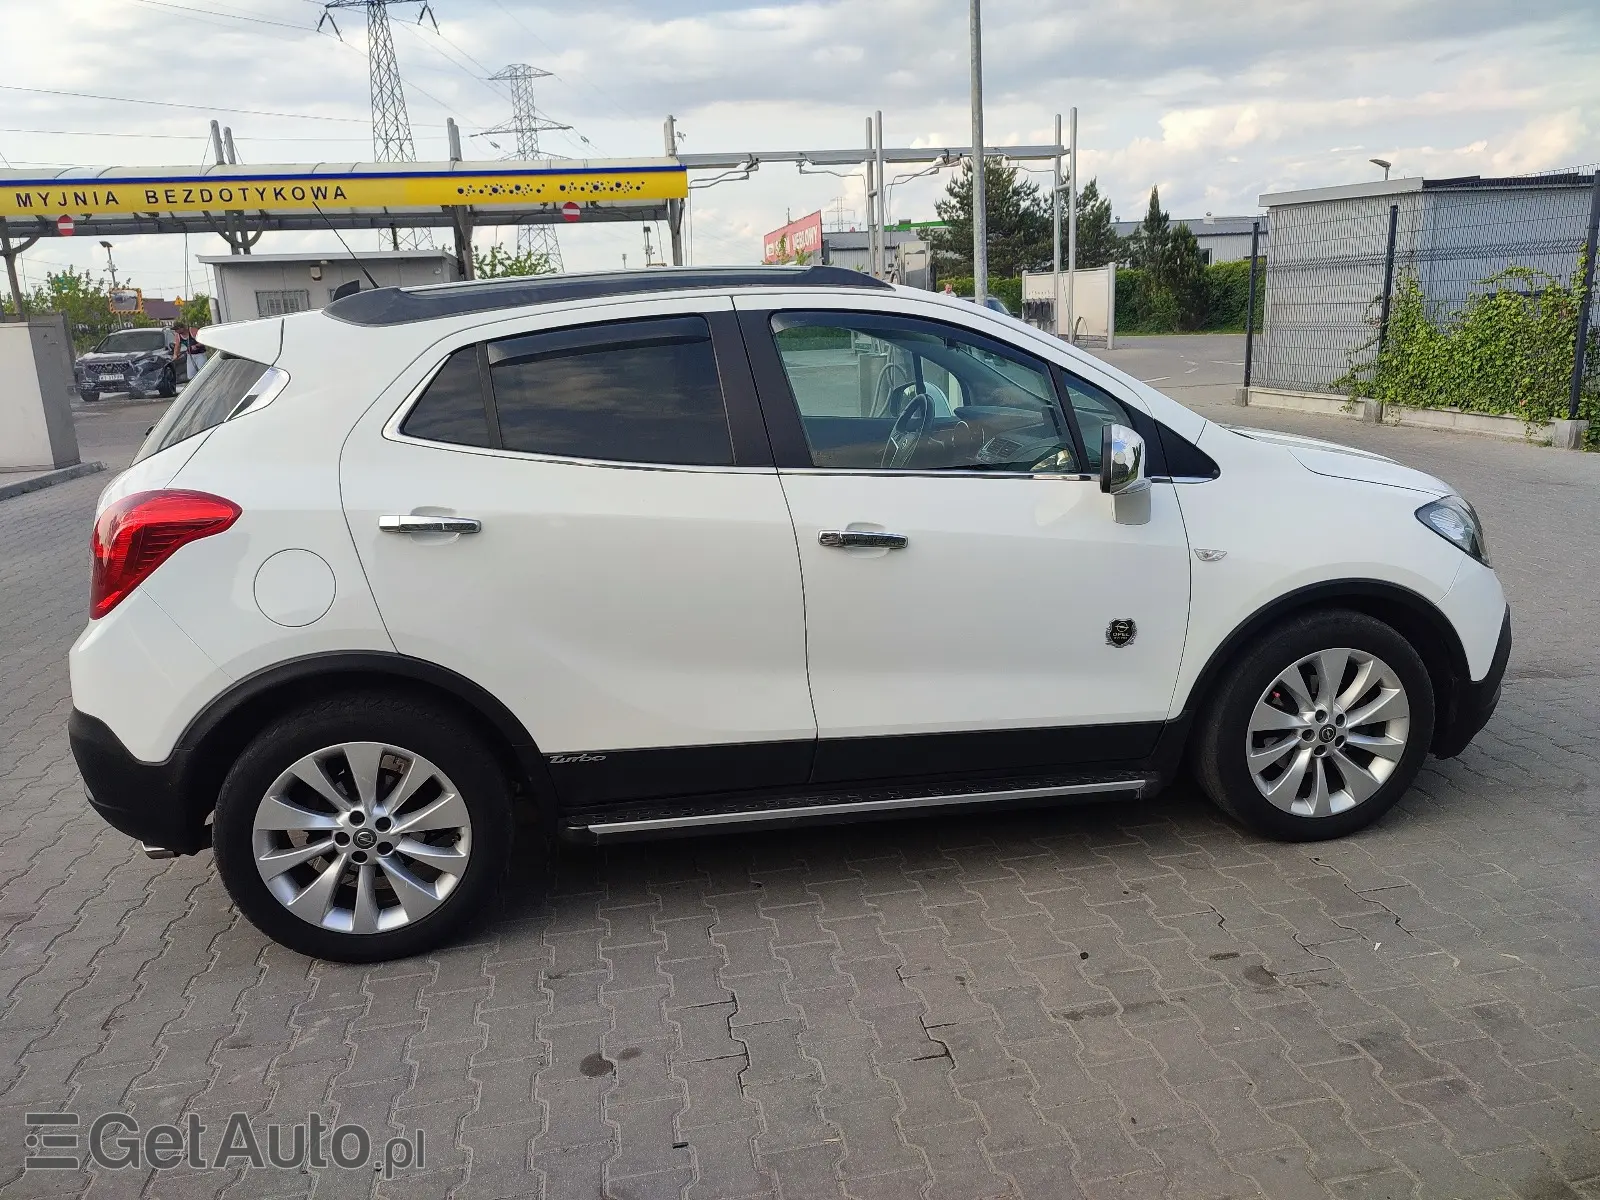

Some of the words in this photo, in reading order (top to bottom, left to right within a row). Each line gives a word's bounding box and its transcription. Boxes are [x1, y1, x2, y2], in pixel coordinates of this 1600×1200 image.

[15, 190, 120, 208] MYJNIA
[145, 185, 348, 205] BEZDOTYKOWA
[549, 753, 607, 764] Turbo
